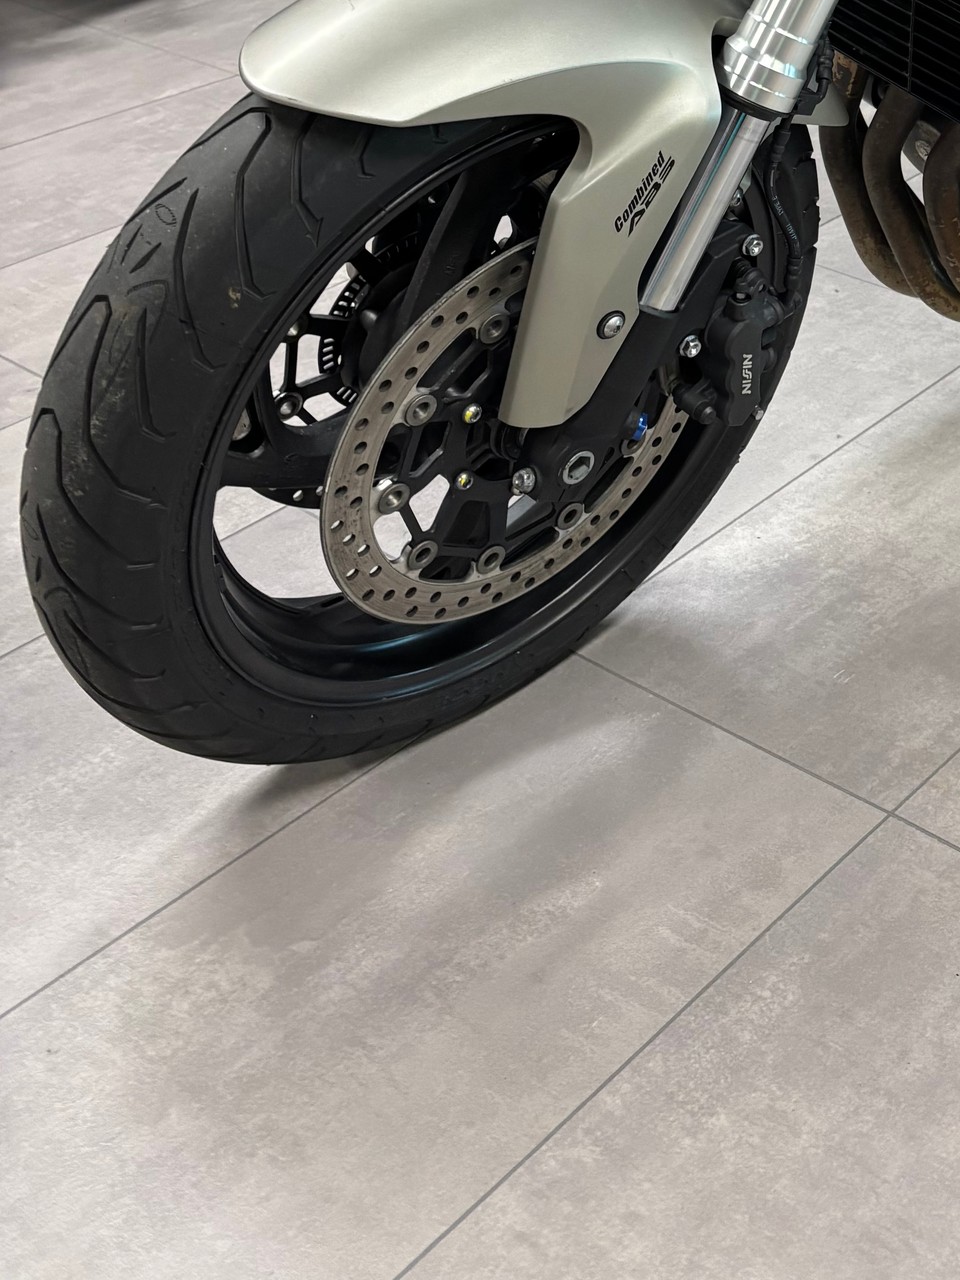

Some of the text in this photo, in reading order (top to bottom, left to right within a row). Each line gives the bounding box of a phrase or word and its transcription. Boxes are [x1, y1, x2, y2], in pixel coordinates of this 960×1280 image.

[614, 150, 665, 233] Combined
[628, 156, 675, 238] ABS
[742, 353, 753, 395] NISSIN
